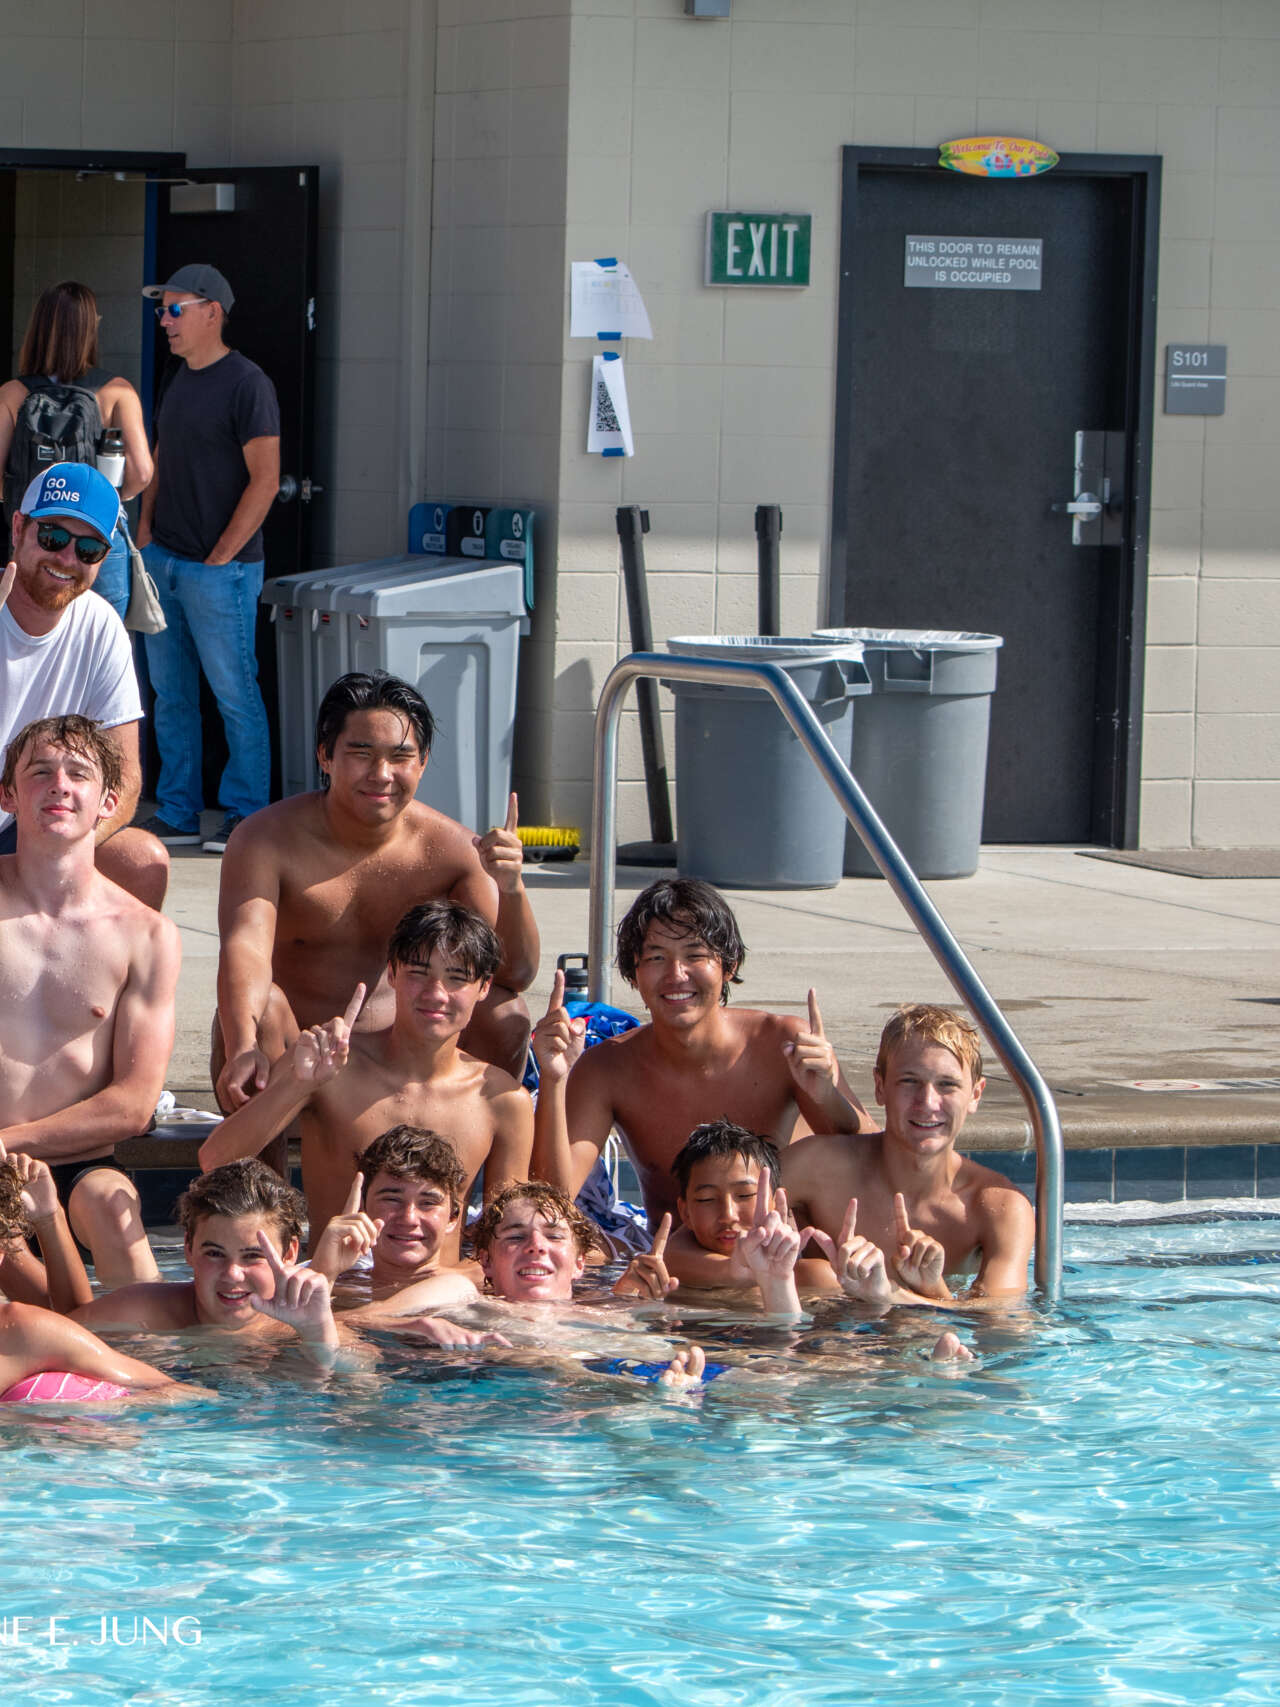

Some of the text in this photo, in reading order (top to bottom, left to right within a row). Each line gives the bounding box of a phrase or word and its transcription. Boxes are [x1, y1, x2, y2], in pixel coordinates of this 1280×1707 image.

[726, 222, 799, 277] EXIT
[909, 241, 1040, 256] THIS DOOR TO REMAIN
[907, 256, 1039, 270] UNLOCKED WHILE POOL
[935, 270, 1012, 283] IS OCCUPIED
[1172, 351, 1208, 367] S101
[46, 478, 67, 488] GO
[43, 490, 80, 502] DONS
